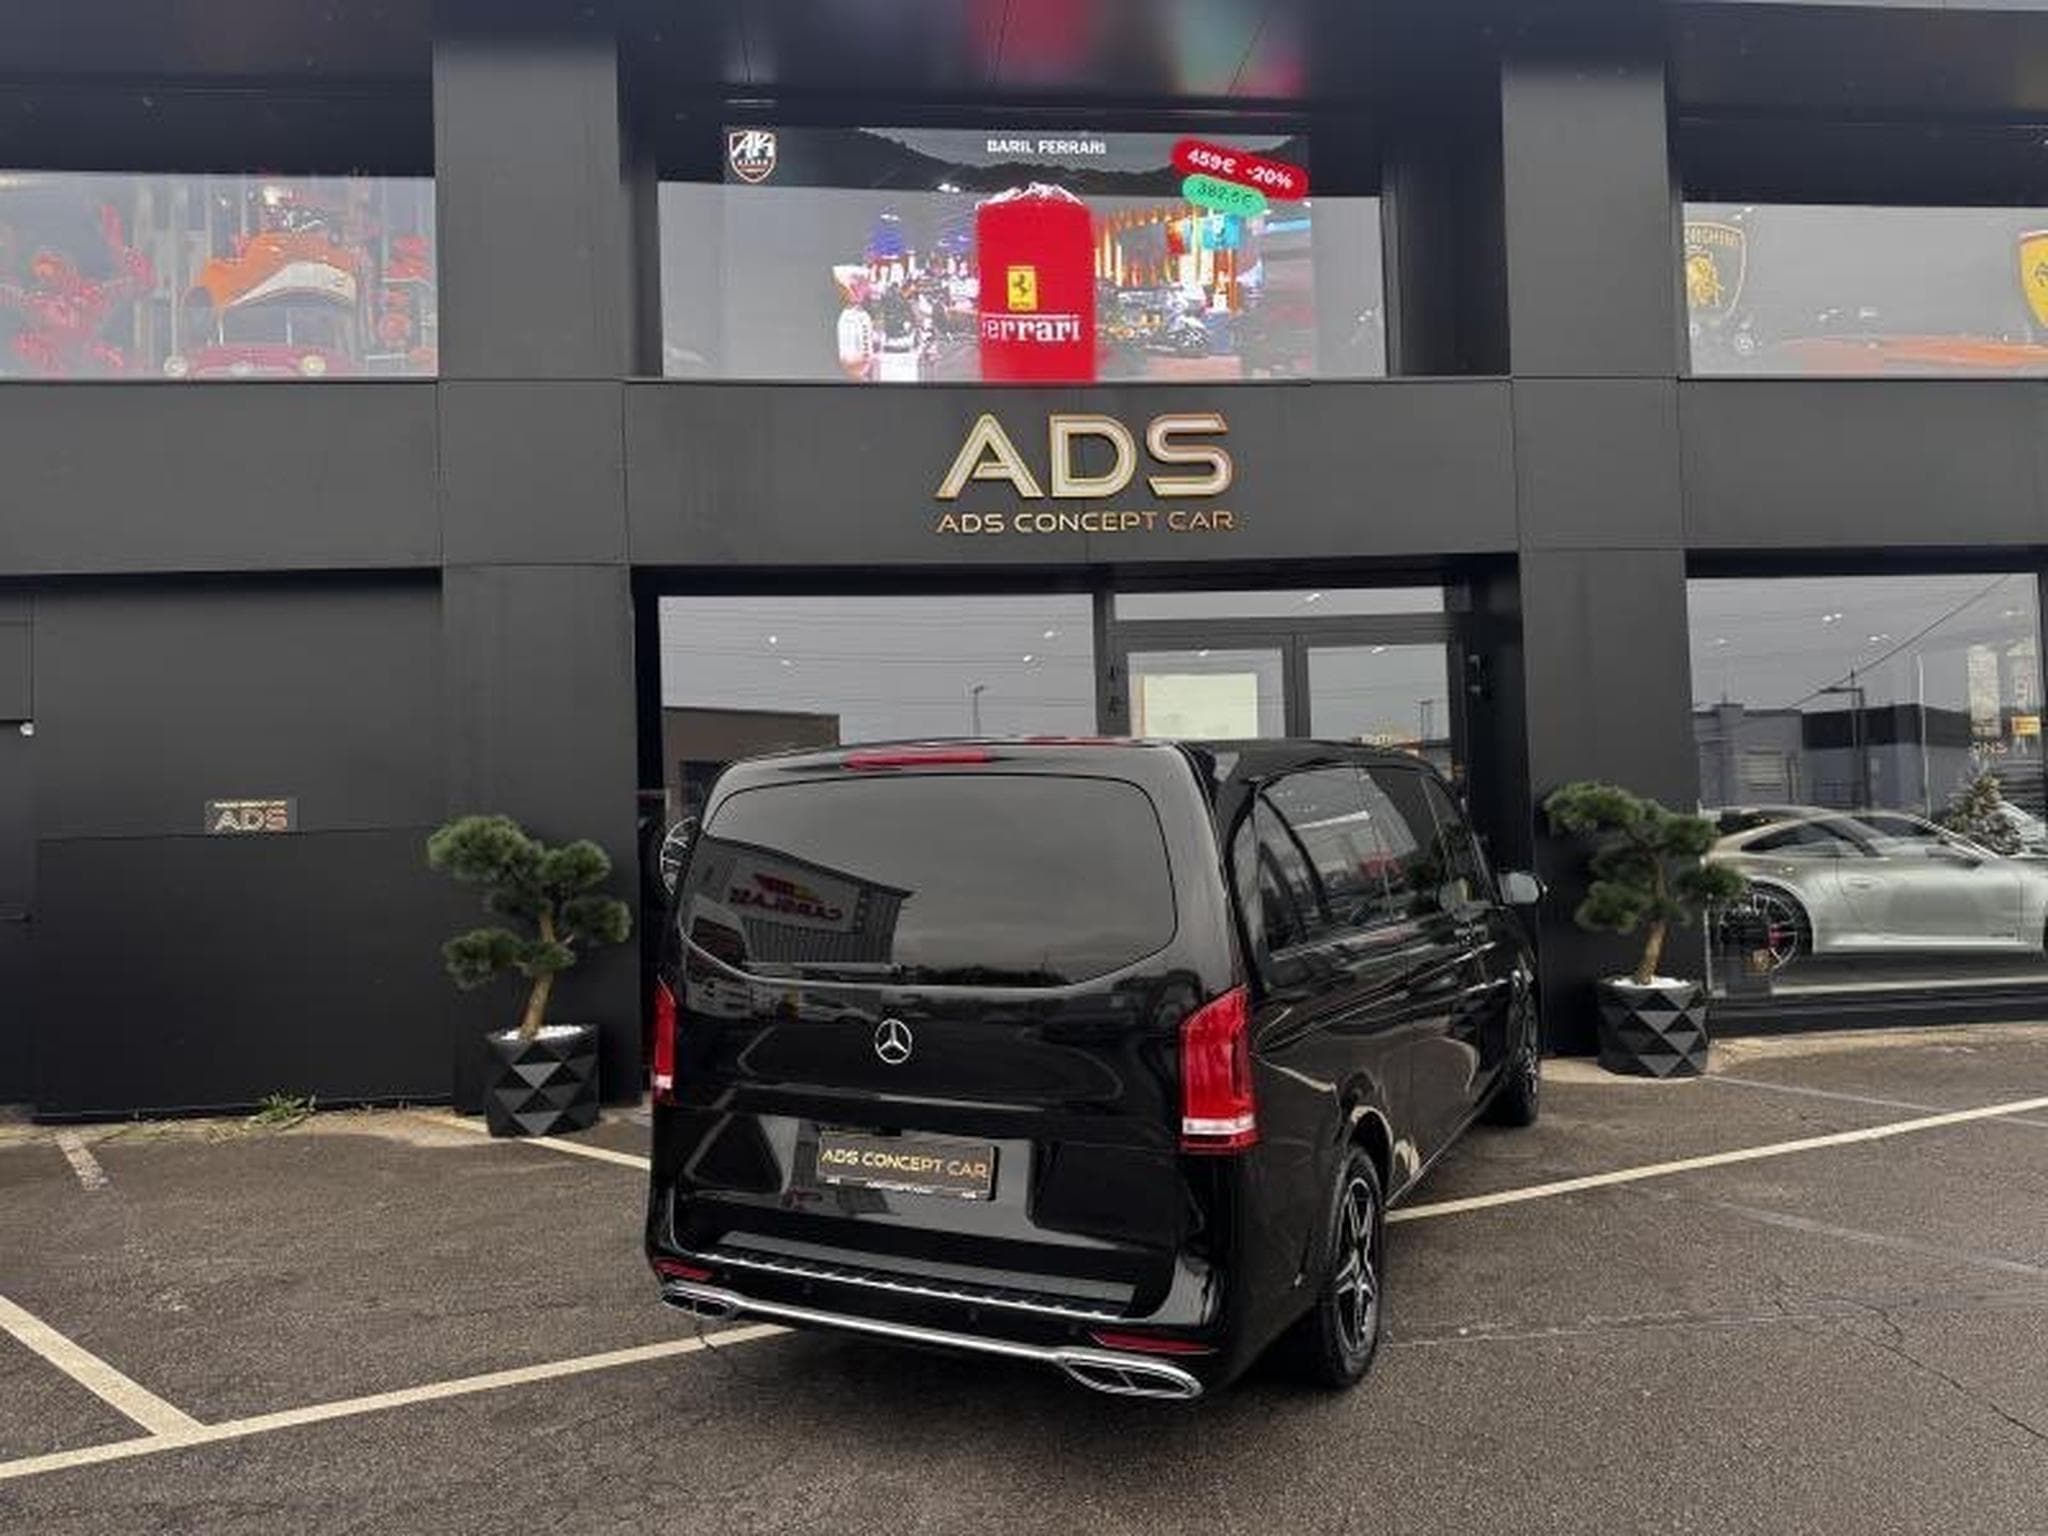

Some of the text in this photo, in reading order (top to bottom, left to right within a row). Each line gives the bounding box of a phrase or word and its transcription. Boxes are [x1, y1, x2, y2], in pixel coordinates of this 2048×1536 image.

[987, 139, 1107, 155] BARIL FERRARI
[934, 412, 1234, 501] ADS
[936, 510, 1236, 534] ADS CONCEPT CAR
[215, 809, 289, 832] ADS
[821, 1149, 988, 1178] ADS CONCEPT CAR
